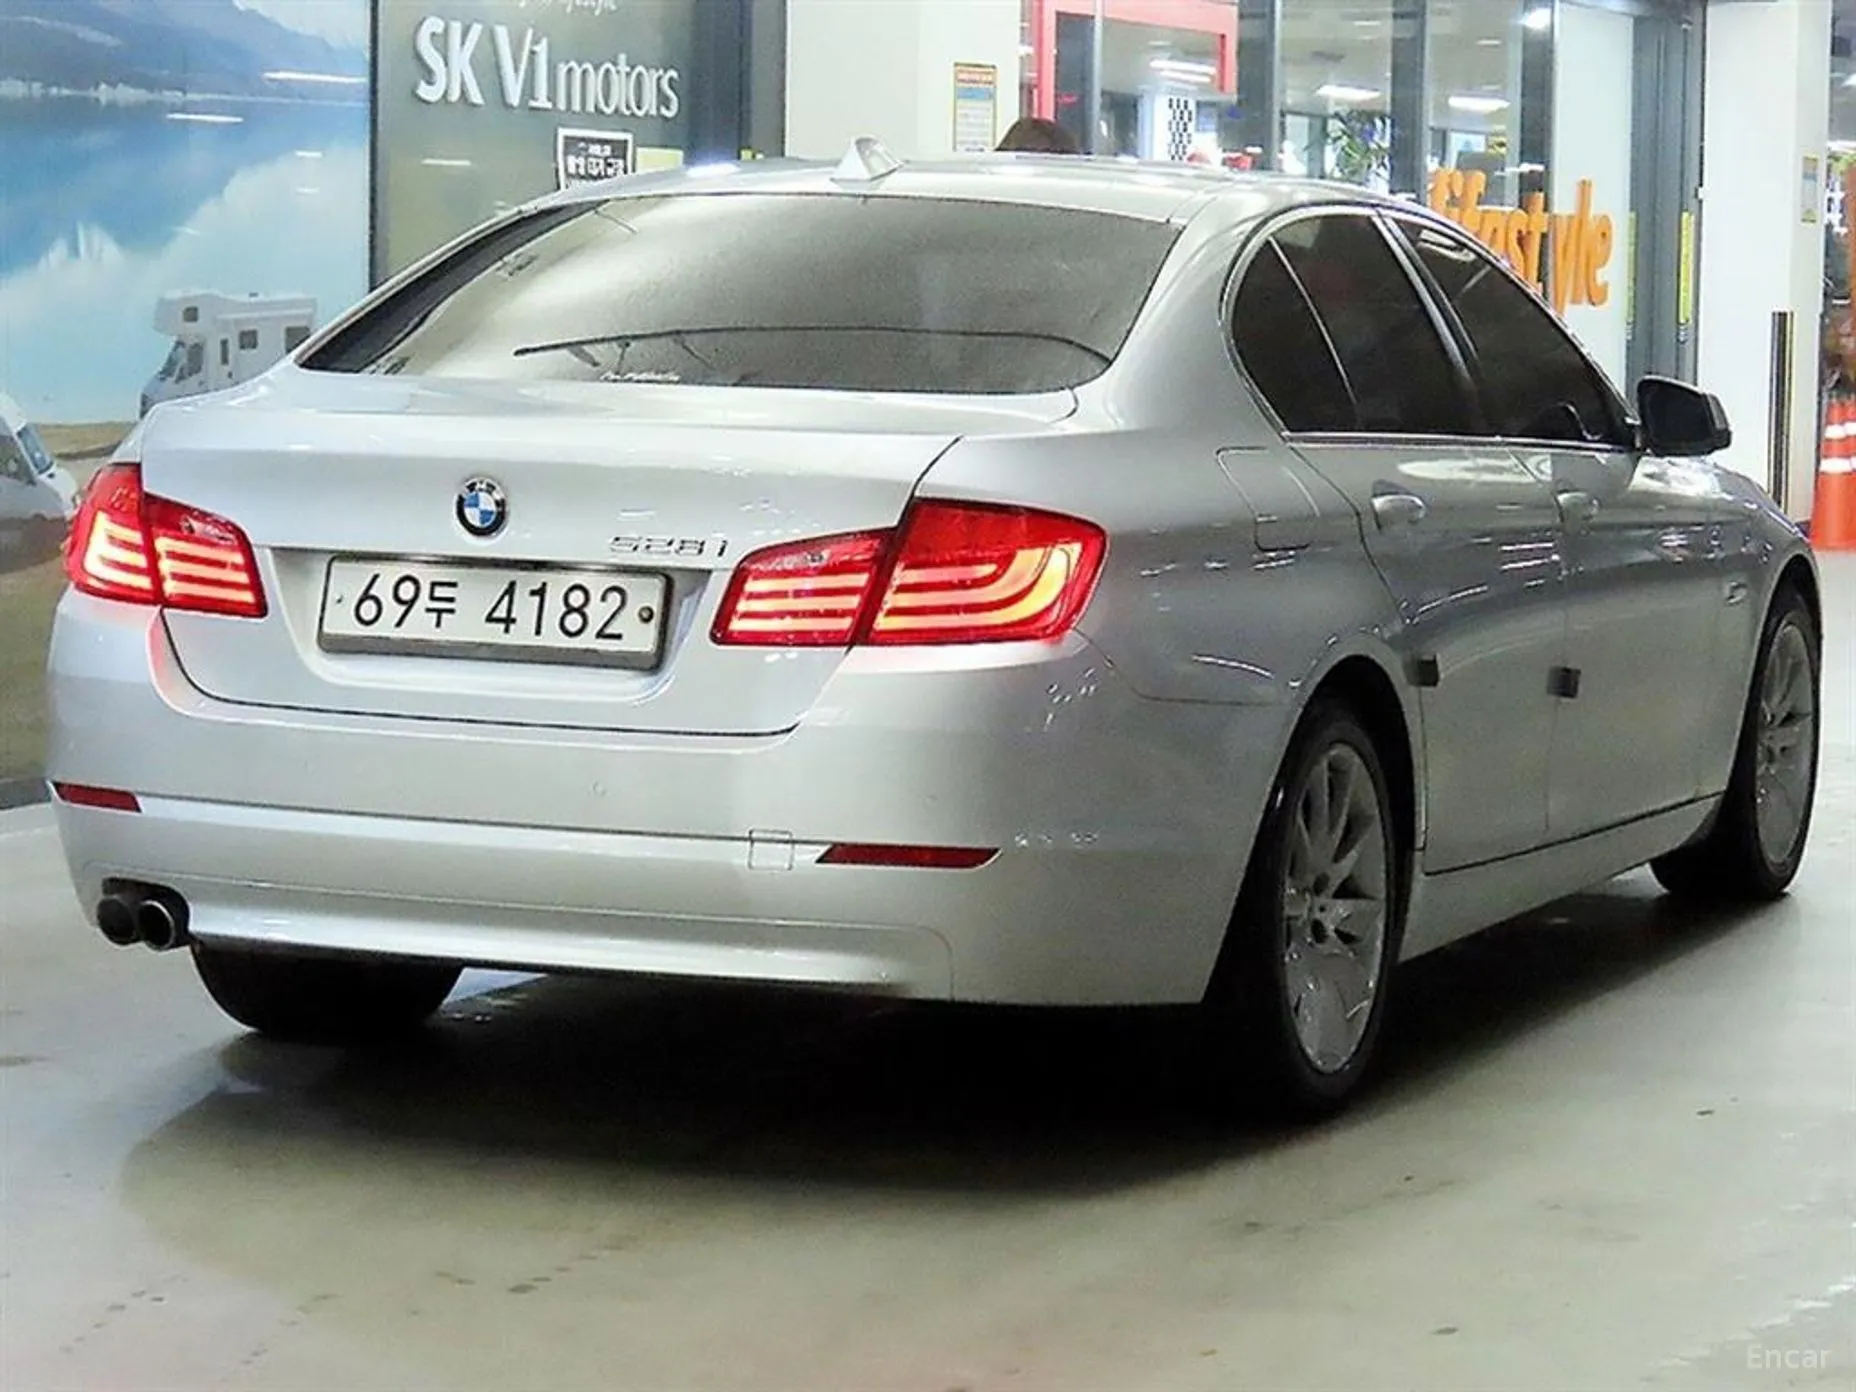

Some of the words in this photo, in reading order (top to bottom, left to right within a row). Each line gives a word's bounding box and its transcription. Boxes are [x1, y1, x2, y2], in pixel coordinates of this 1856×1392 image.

[415, 15, 485, 107] SK
[493, 24, 552, 109] V1
[555, 52, 680, 118] motors
[353, 573, 459, 629] 69두
[484, 579, 629, 641] 4182
